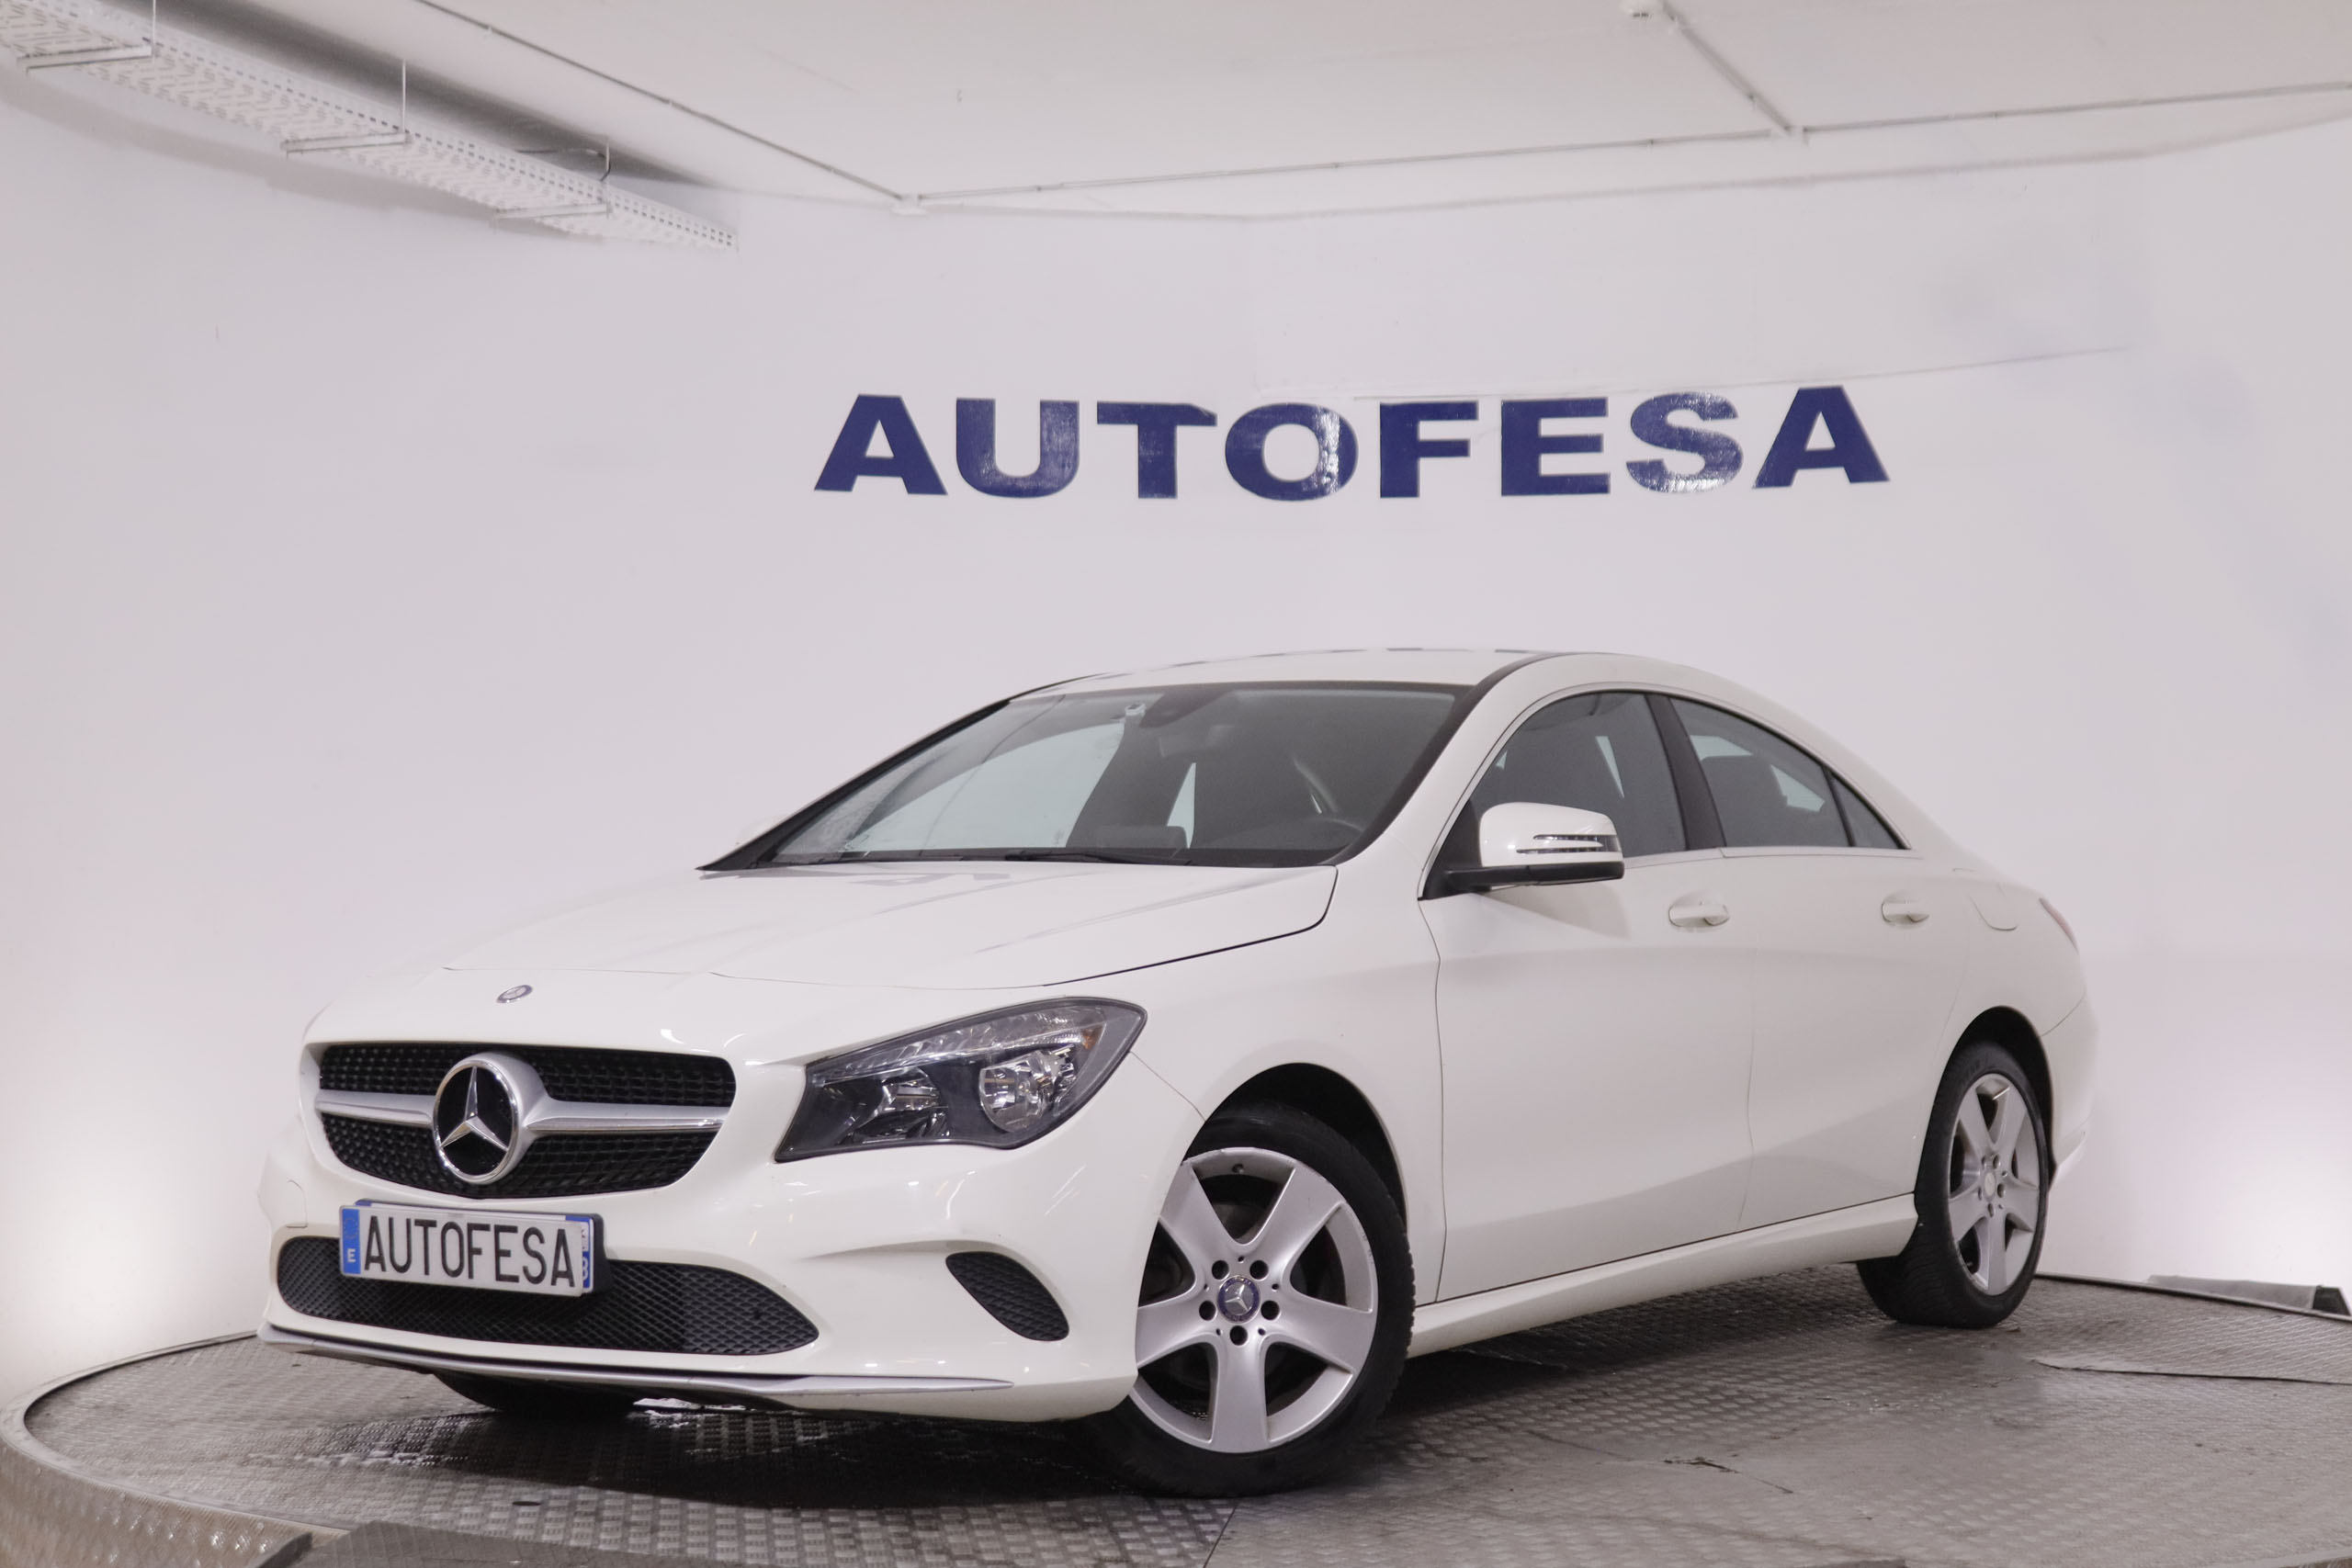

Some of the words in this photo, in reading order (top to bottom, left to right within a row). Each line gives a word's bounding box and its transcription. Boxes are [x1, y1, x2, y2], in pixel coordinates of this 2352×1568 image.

[815, 387, 1889, 502] AUTOFESA
[347, 1248, 356, 1263] E
[364, 1214, 575, 1288] AUTOFESA
